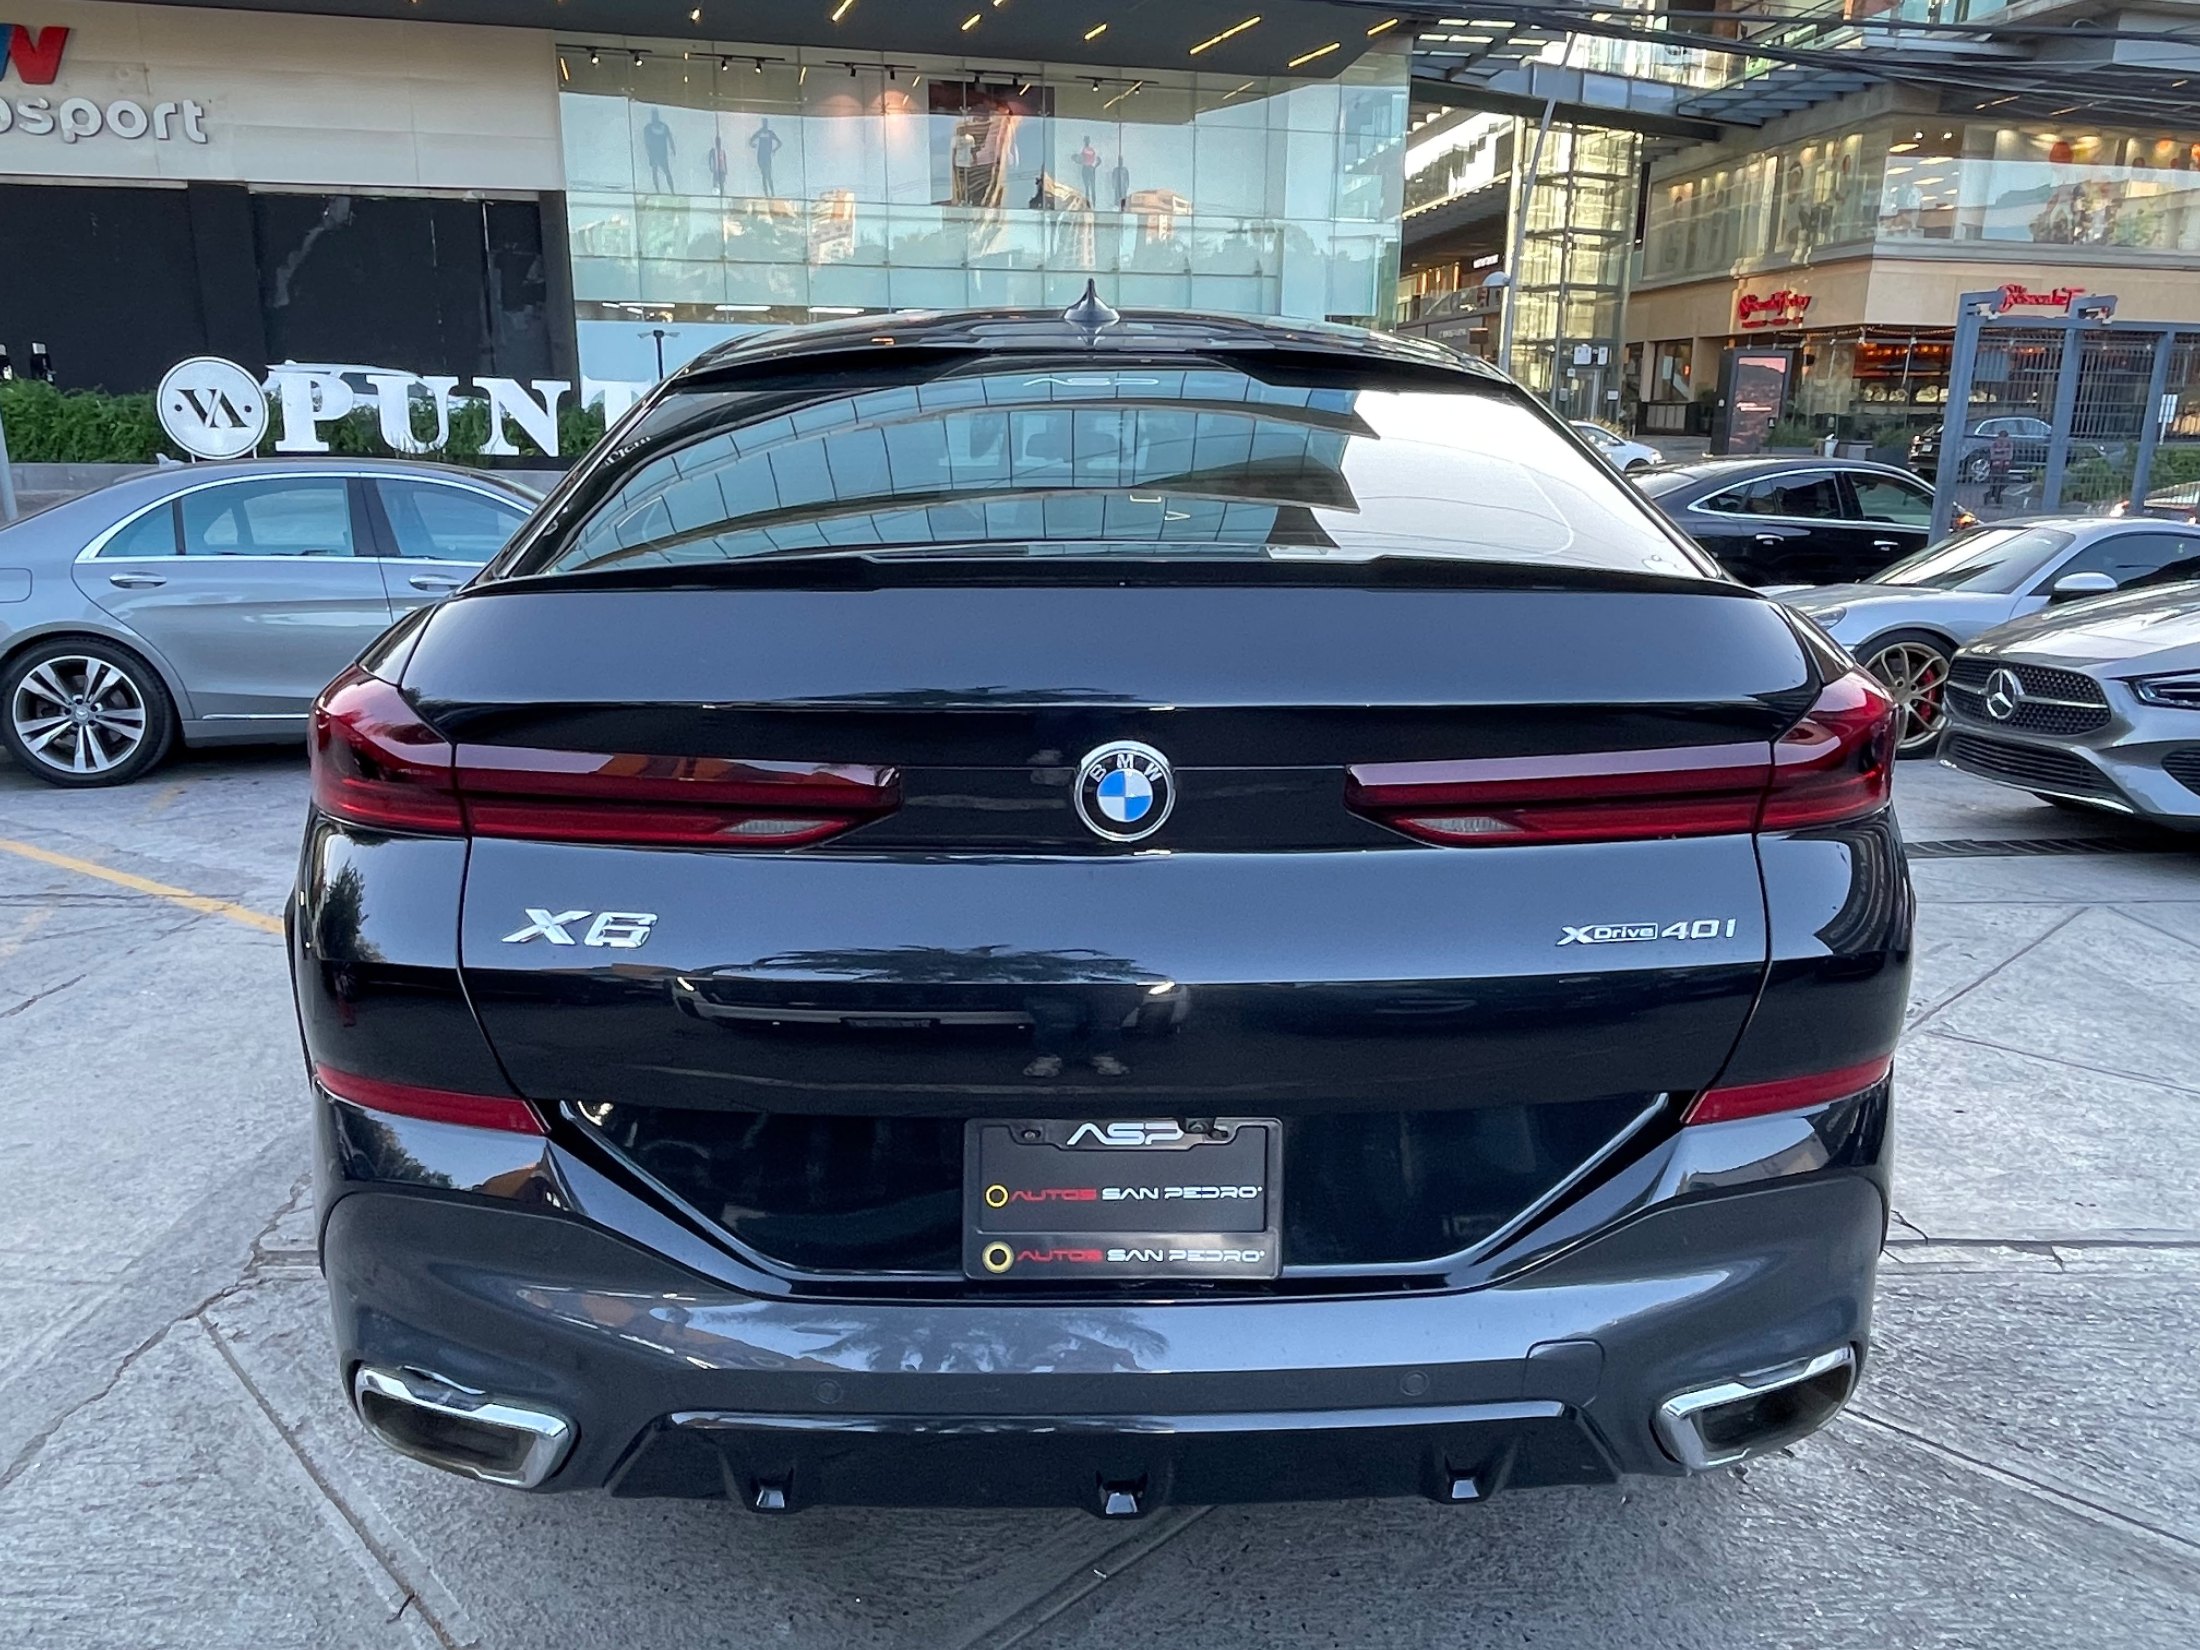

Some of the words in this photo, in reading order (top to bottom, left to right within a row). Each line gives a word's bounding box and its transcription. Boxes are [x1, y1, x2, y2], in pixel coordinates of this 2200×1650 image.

[1089, 753, 1163, 782] BMW
[502, 908, 659, 949] X6
[1066, 1122, 1185, 1146] ASP
[1011, 1188, 1097, 1201] AUTOS
[1102, 1187, 1159, 1201] SAN
[1164, 1186, 1258, 1201] PEDRO
[1016, 1249, 1102, 1263] AUTOS
[1107, 1248, 1164, 1263] SAN
[1168, 1249, 1261, 1263] PEDRO
